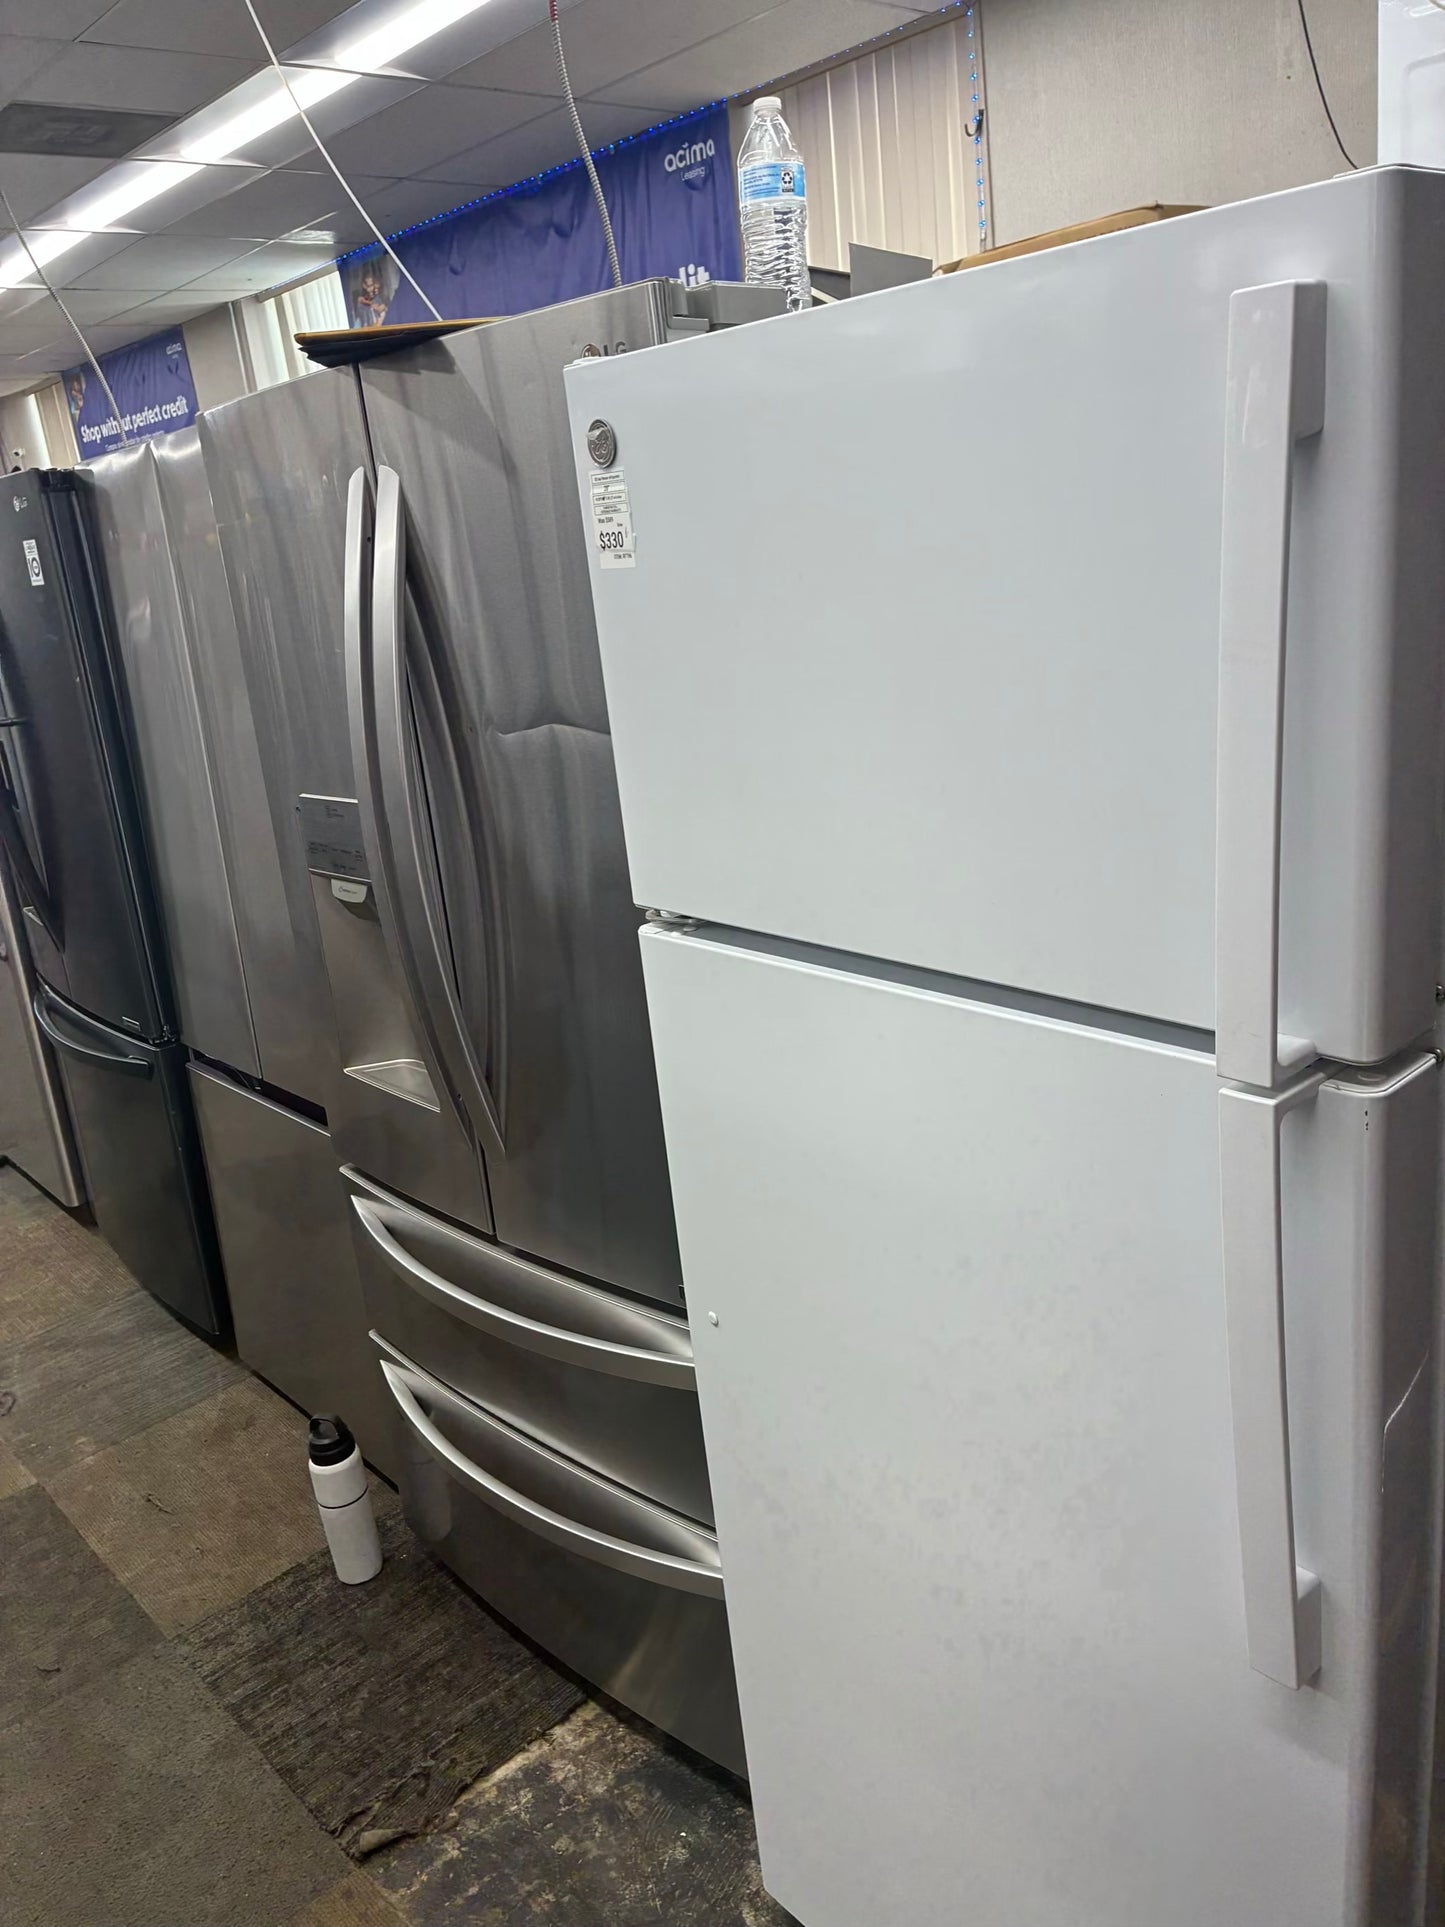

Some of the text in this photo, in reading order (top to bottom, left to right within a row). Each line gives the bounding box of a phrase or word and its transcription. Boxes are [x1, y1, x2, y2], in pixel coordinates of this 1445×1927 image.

[664, 139, 715, 172] acima
[81, 424, 101, 443] Shop
[100, 414, 132, 437] withut
[132, 404, 161, 432] perfect
[161, 395, 189, 420] credit
[600, 530, 624, 551] $330
